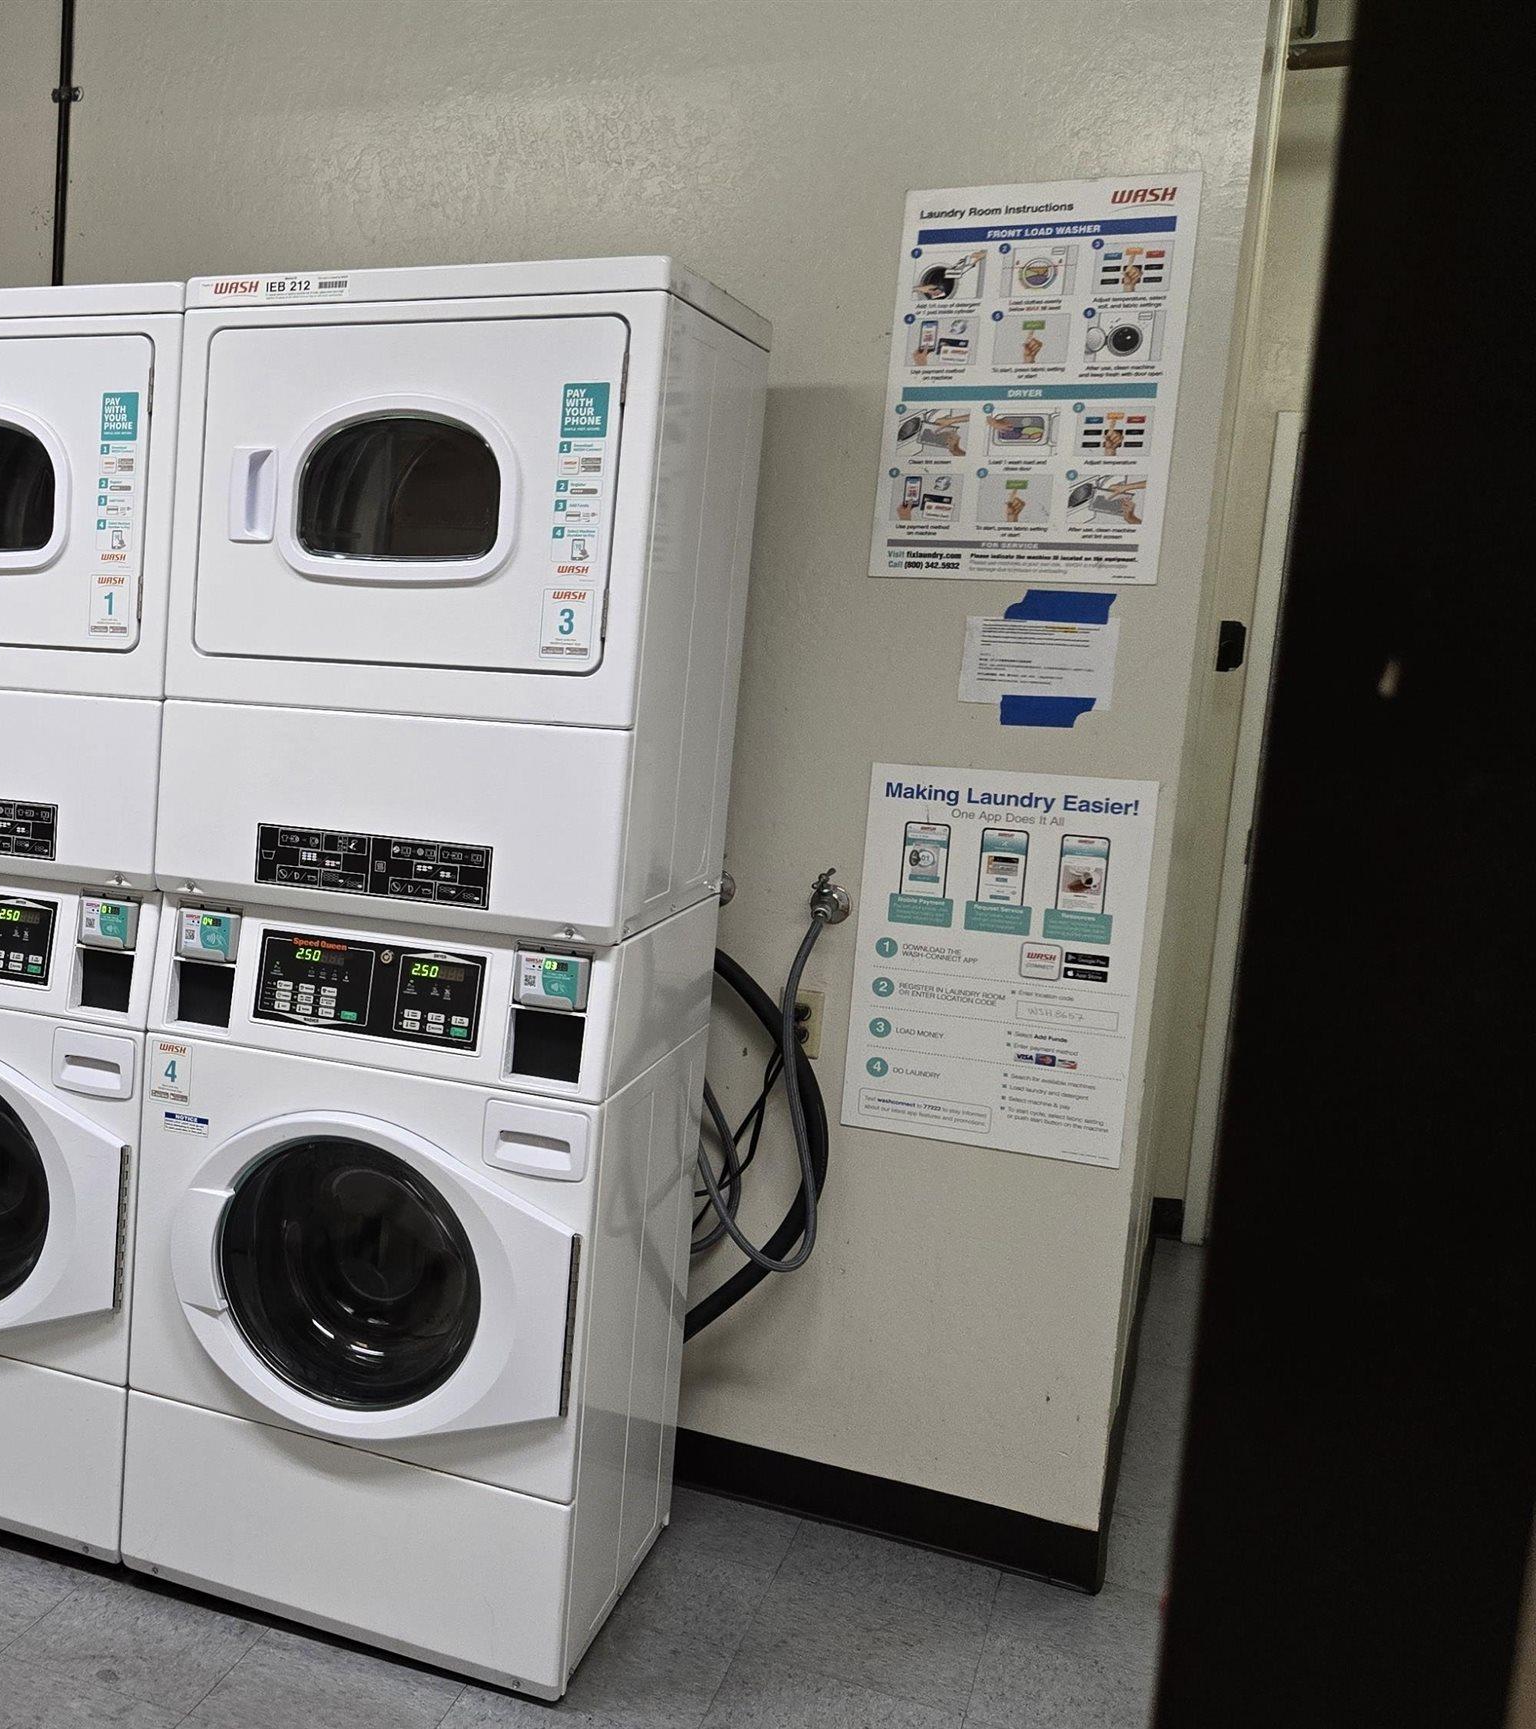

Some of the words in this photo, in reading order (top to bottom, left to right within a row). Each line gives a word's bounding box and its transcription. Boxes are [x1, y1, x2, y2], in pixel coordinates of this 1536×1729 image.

[1111, 187, 1177, 204] WASH
[920, 207, 965, 219] Laundry
[969, 205, 1002, 217] Room
[1005, 201, 1074, 214] Instructions
[986, 228, 1022, 239] FRONT
[1024, 226, 1053, 238] LOAD
[1055, 224, 1101, 236] WASHER
[214, 280, 259, 294] WASH
[266, 281, 286, 292] IEB
[290, 280, 311, 291] 212
[567, 388, 587, 398] PAY
[1007, 388, 1043, 399] DRYER
[105, 397, 121, 406] PAY
[566, 397, 593, 407] WITH
[104, 405, 126, 414] WITH
[565, 407, 595, 416] YOUR
[104, 413, 127, 422] YOUR
[564, 416, 602, 426] PHONE
[103, 421, 133, 431] PHONE
[101, 553, 127, 561] WASH
[887, 550, 904, 558] Visit
[906, 551, 961, 561] fixlaundry.com
[557, 565, 589, 574] WASH
[888, 560, 903, 568] Call
[904, 561, 923, 570] (800)
[97, 576, 125, 585] WASH
[552, 591, 586, 600] WASH
[104, 592, 113, 615] 1
[559, 608, 574, 635] 3
[885, 782, 960, 806] Making
[967, 787, 1057, 813] Laundry
[1063, 794, 1139, 816] Easier!
[951, 808, 976, 820] One
[979, 810, 1002, 823] App
[1005, 812, 1036, 824] Does
[1039, 813, 1048, 825] It
[1049, 815, 1065, 827] All
[202, 917, 213, 926] 04
[292, 937, 320, 949] Speed
[320, 941, 348, 951] Queen
[903, 944, 945, 954] DOWNLOAD
[947, 947, 962, 955] THE
[902, 950, 961, 962] WASH-CONNECT
[1026, 952, 1057, 961] WASH
[412, 963, 439, 978] 2.50
[1075, 972, 1087, 980] App
[1088, 973, 1103, 981] Store
[879, 981, 888, 992] 2
[899, 982, 934, 991] REGISTER
[945, 987, 980, 998] LAUNDRY
[982, 992, 1006, 1000] ROOM
[911, 990, 936, 999] ENTER
[937, 993, 974, 1004] LOCATION
[975, 998, 997, 1007] CODE
[876, 1021, 885, 1033] 3
[896, 1027, 916, 1036] LOAD
[916, 1030, 944, 1039] MONEY
[159, 1043, 187, 1054] WASH
[1016, 1053, 1034, 1061] VISA
[164, 1060, 177, 1083] 4
[873, 1060, 882, 1072] 4
[893, 1067, 904, 1075] DO
[905, 1069, 941, 1079] LAUNDRY
